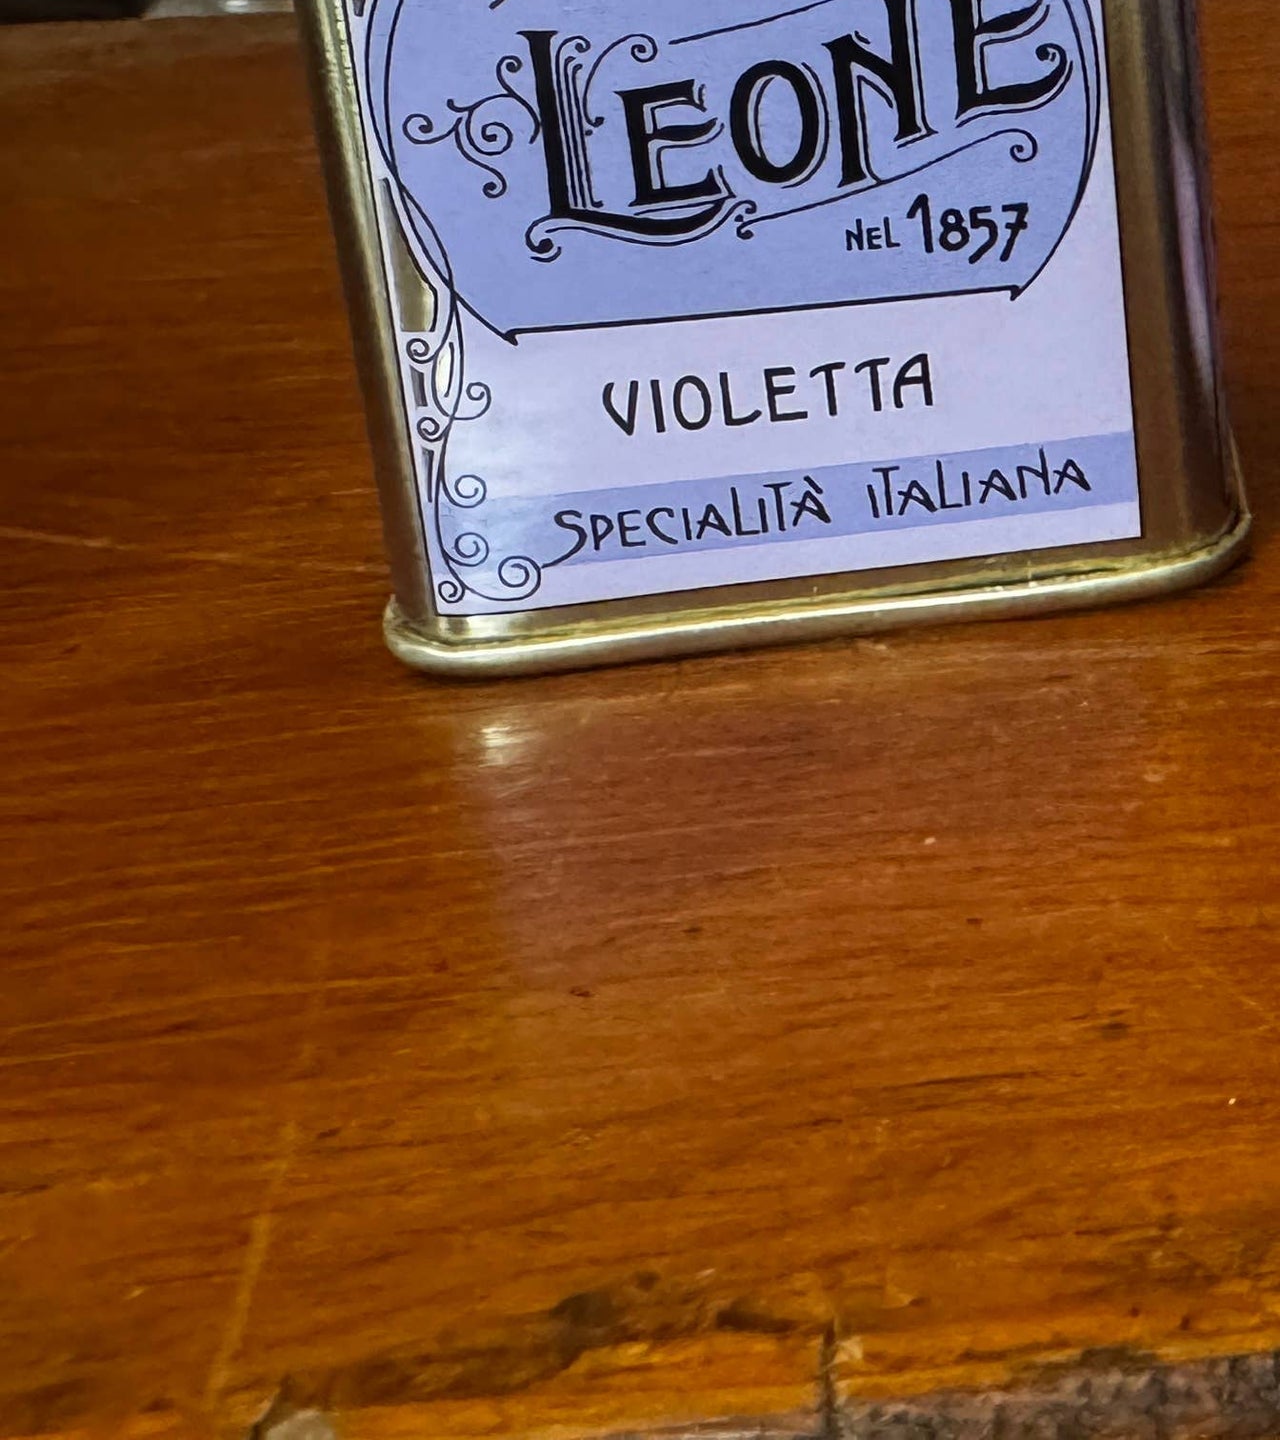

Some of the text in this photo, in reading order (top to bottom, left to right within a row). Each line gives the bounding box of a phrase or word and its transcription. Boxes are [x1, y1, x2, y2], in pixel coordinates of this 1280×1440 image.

[904, 192, 1031, 266] 1857
[601, 351, 936, 437] VIOLETTA
[540, 445, 1093, 569] SPECIALITÀ ITALIANA
